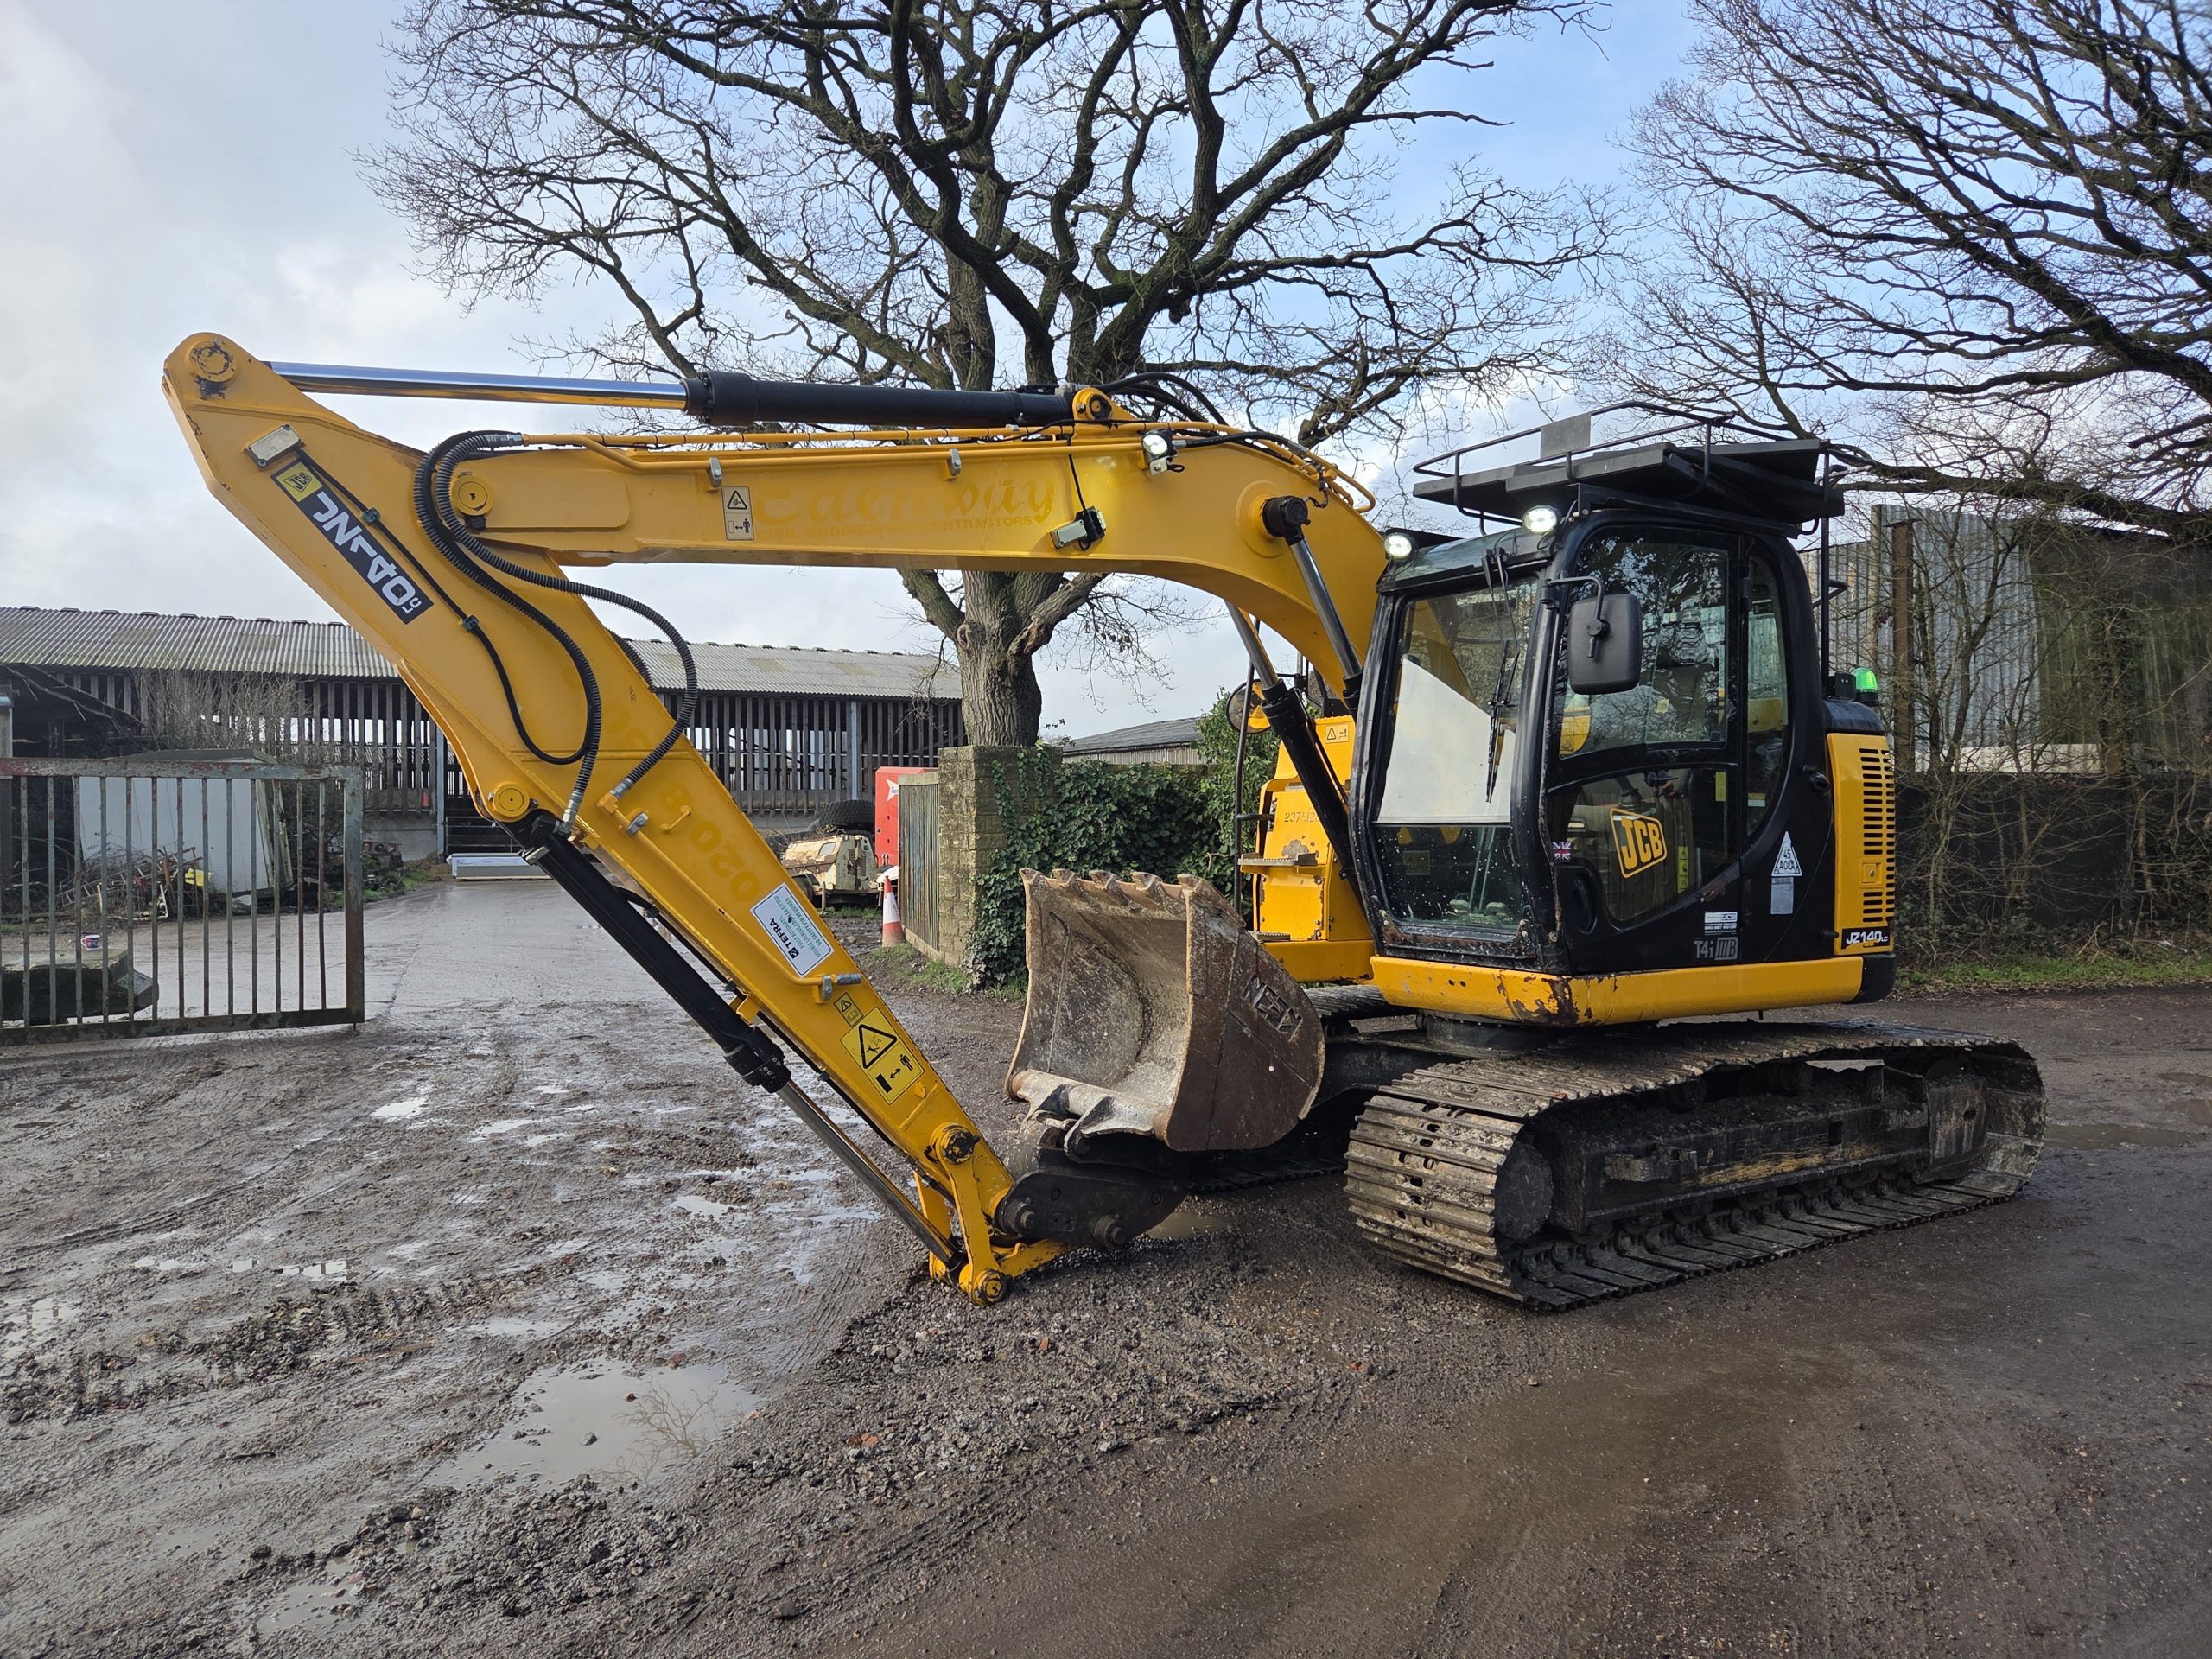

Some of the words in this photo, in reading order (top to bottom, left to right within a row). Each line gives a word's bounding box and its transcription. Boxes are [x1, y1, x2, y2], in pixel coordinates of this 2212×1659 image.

[289, 472, 310, 490] JCB
[1621, 817, 1663, 870] JCB
[768, 918, 792, 948] TEFRA
